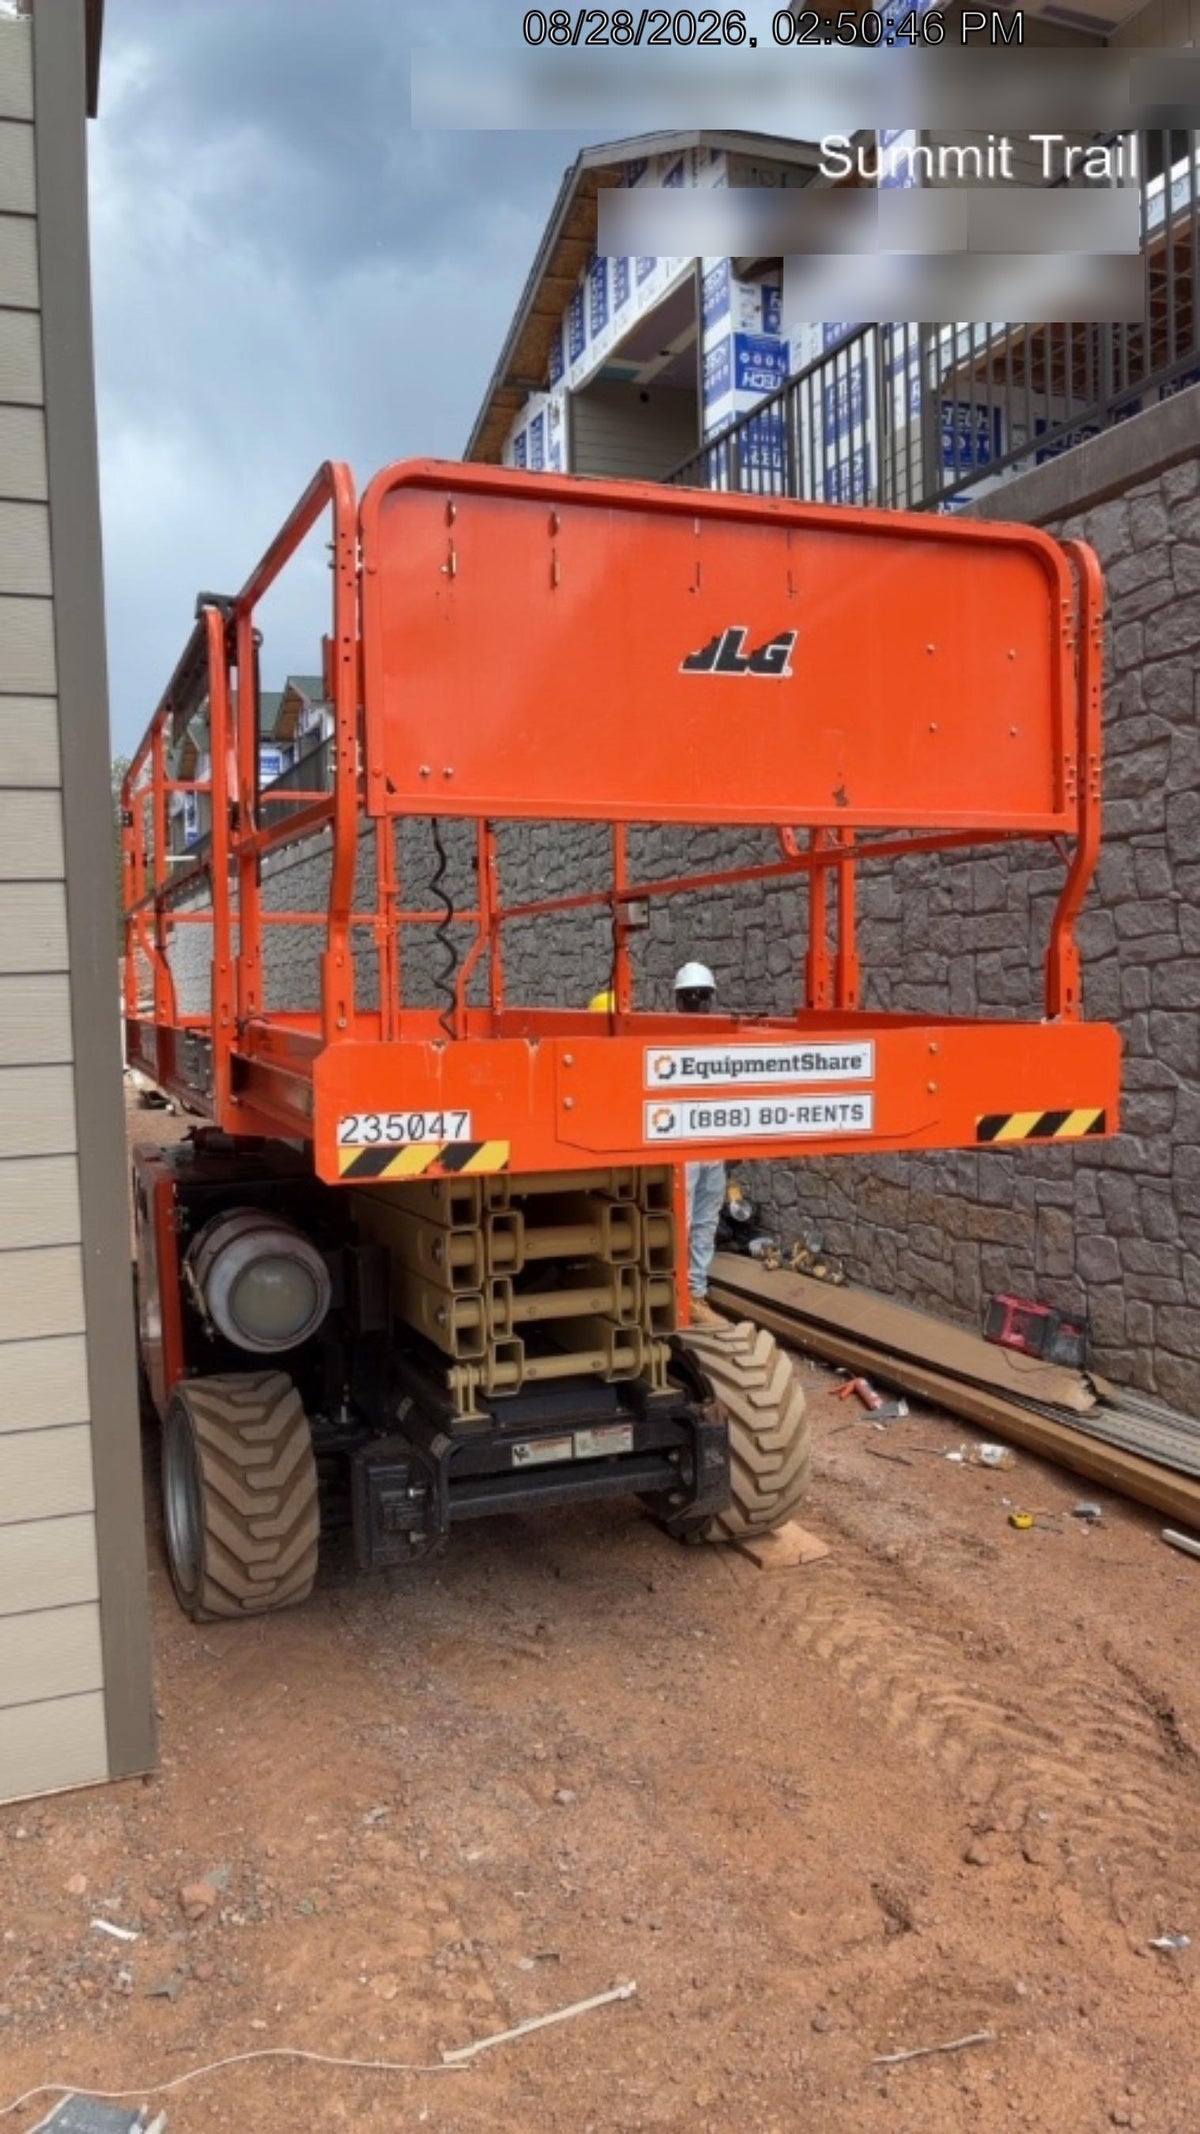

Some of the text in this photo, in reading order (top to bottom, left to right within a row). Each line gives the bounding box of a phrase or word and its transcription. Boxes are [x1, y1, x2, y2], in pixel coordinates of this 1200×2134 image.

[678, 625, 798, 678] JLG
[680, 1051, 863, 1079] EquipmentShare
[339, 1111, 468, 1144] 235047
[689, 1103, 864, 1130] (888) 80-RENTS
